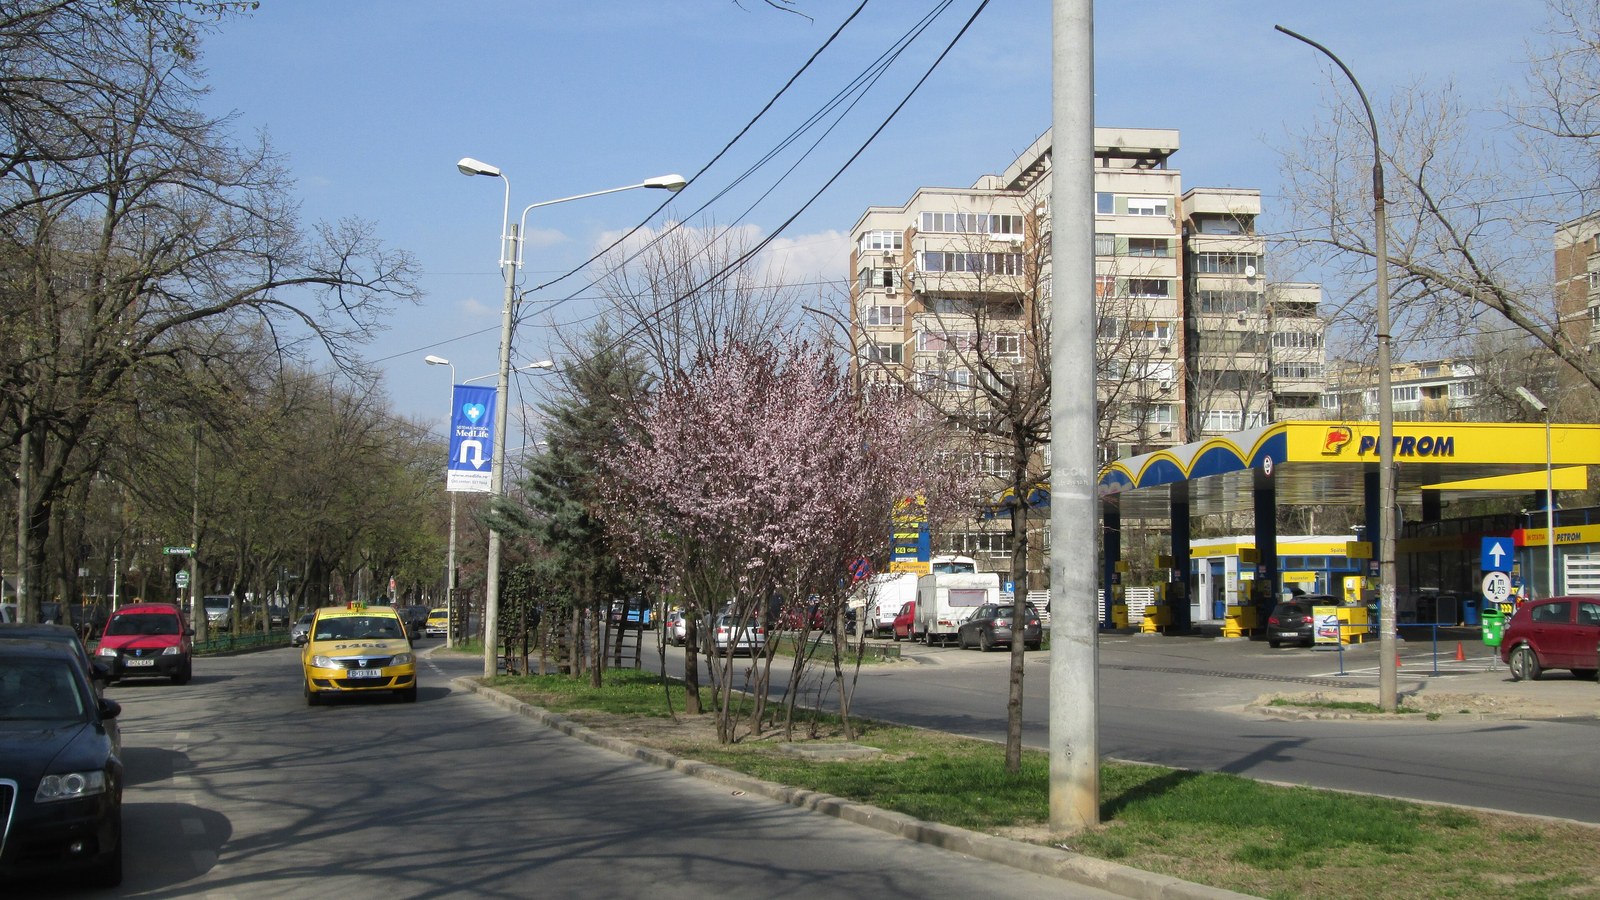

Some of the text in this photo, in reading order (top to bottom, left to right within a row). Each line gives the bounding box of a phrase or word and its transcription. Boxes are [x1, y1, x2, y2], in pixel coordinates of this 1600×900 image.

[455, 429, 489, 438] MedLife
[1556, 532, 1581, 542] PETROM
[1006, 582, 1013, 592] P
